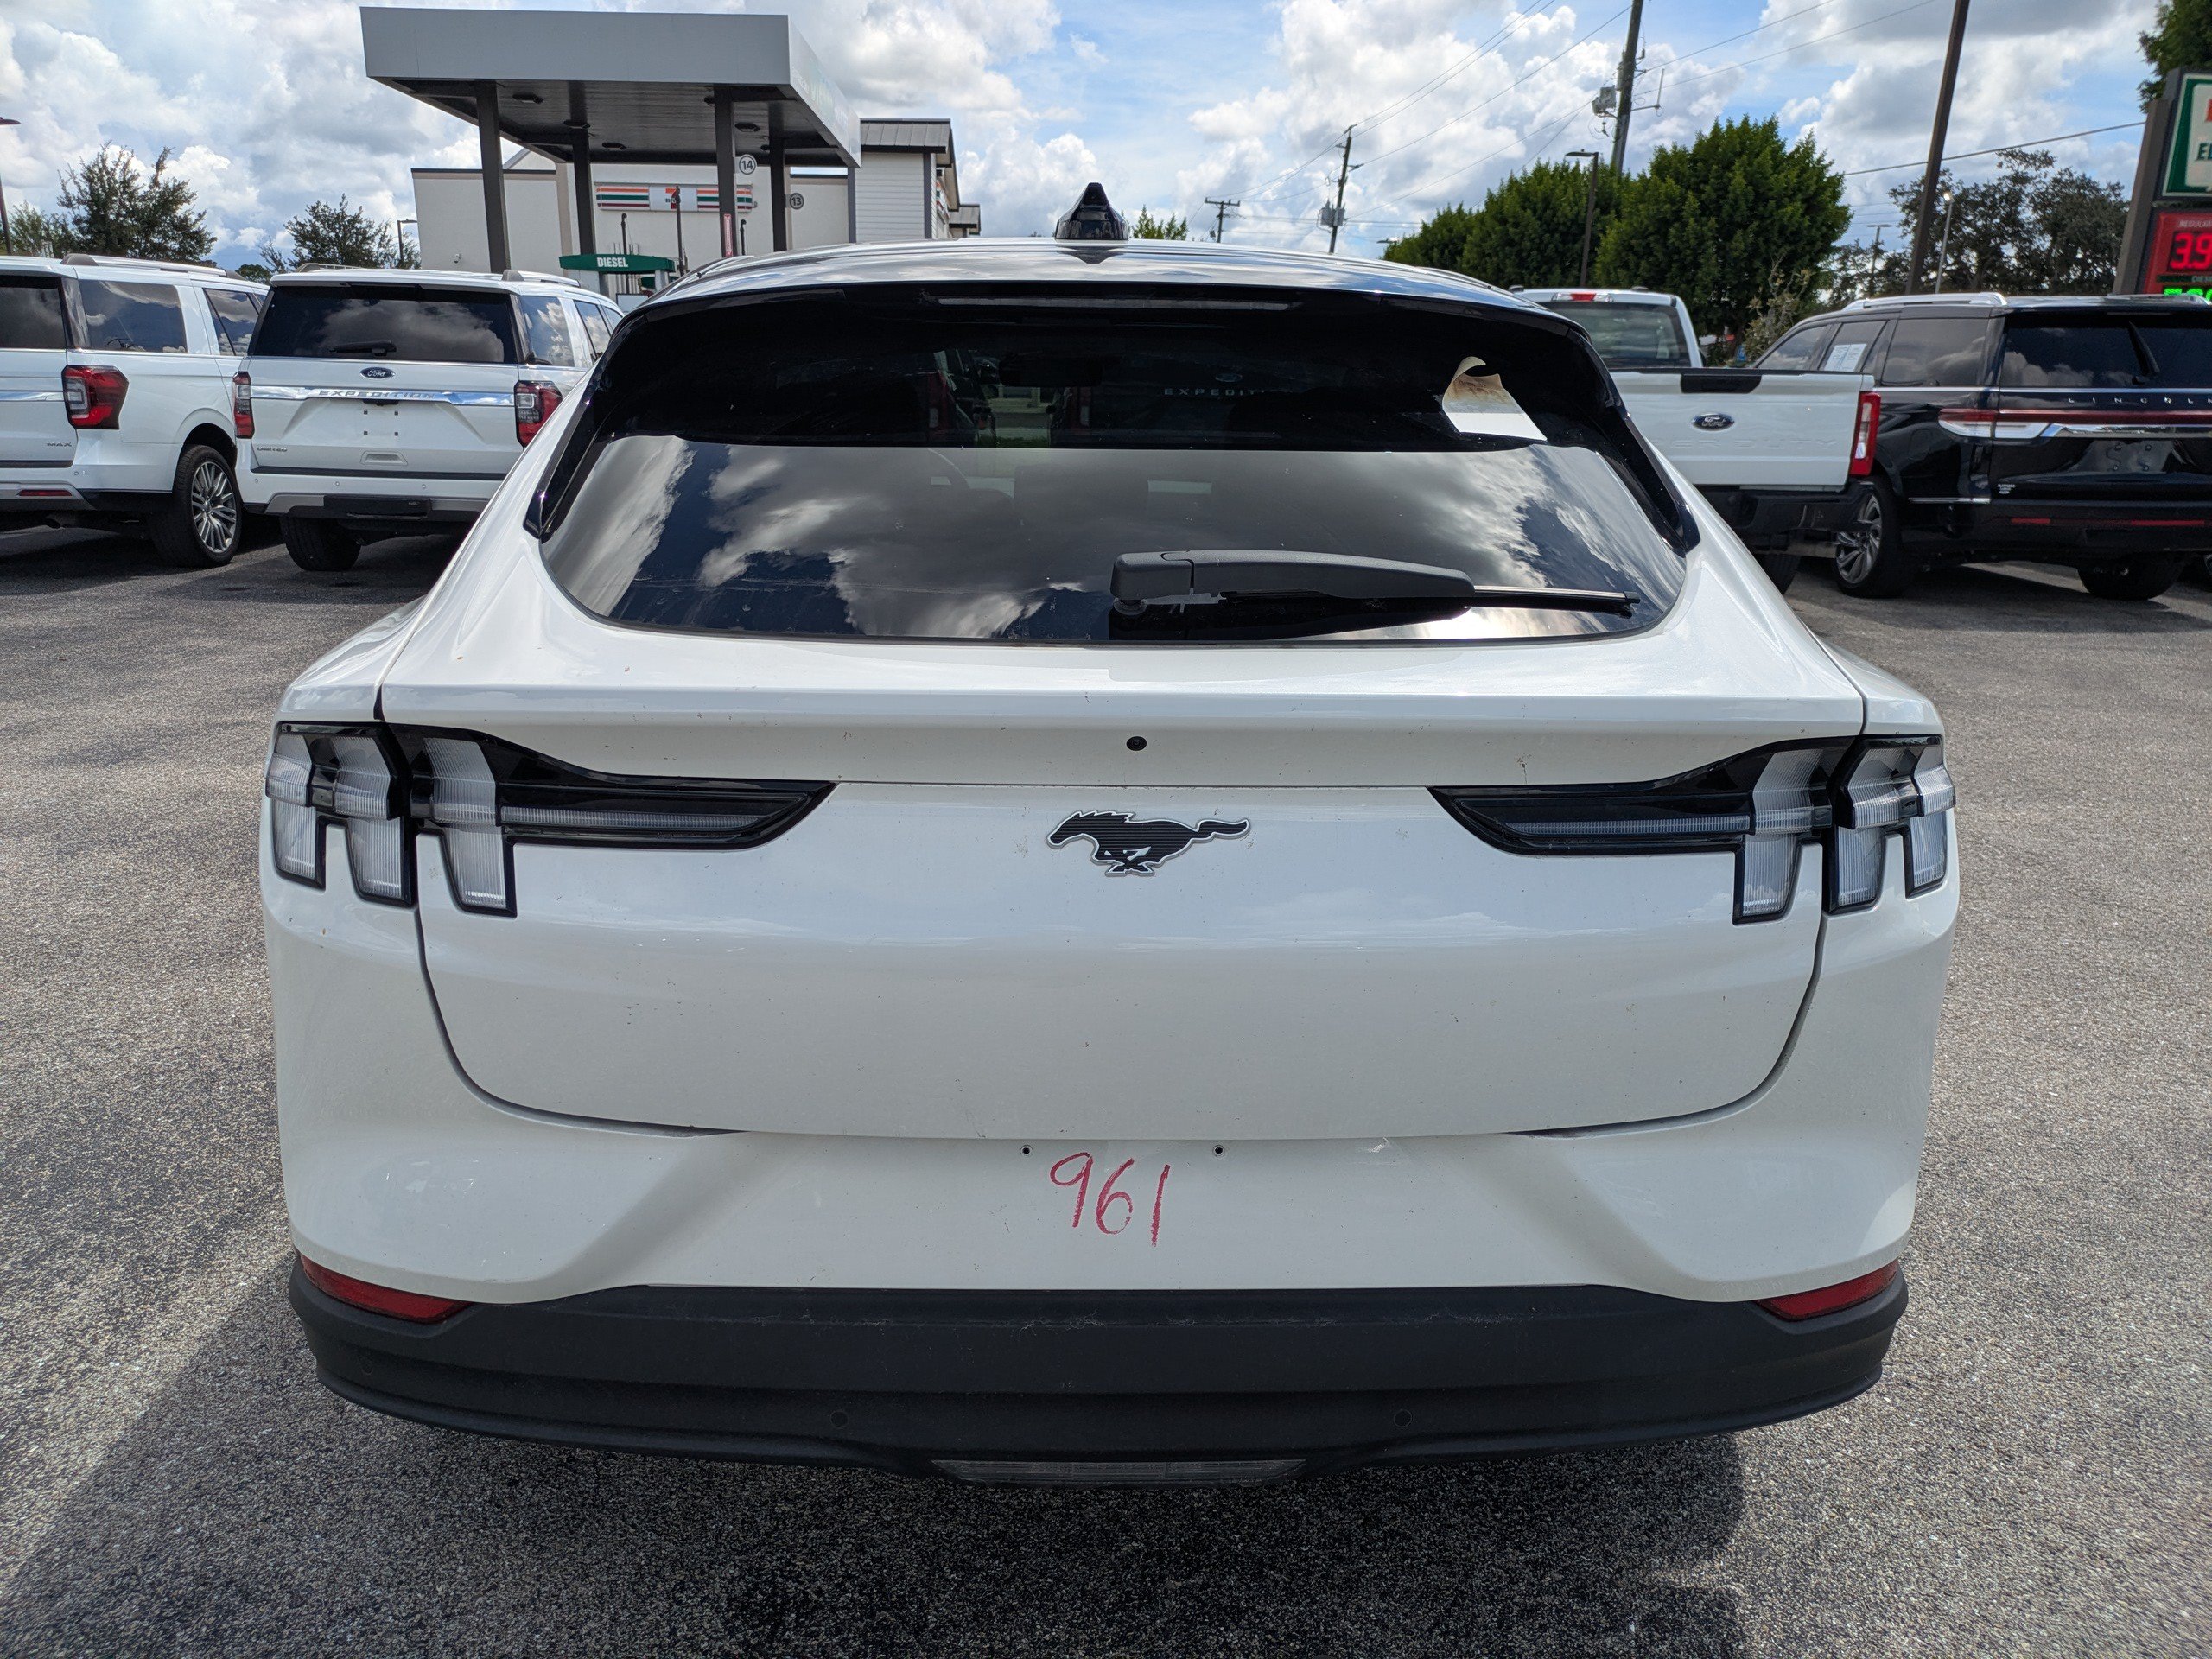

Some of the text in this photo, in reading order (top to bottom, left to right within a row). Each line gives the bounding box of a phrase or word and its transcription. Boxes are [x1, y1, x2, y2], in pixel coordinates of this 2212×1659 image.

[741, 160, 753, 171] 14
[791, 196, 802, 207] 13
[596, 257, 629, 268] DIESEL
[319, 390, 435, 398] EXPEDITION
[1049, 1151, 1171, 1248] 961
